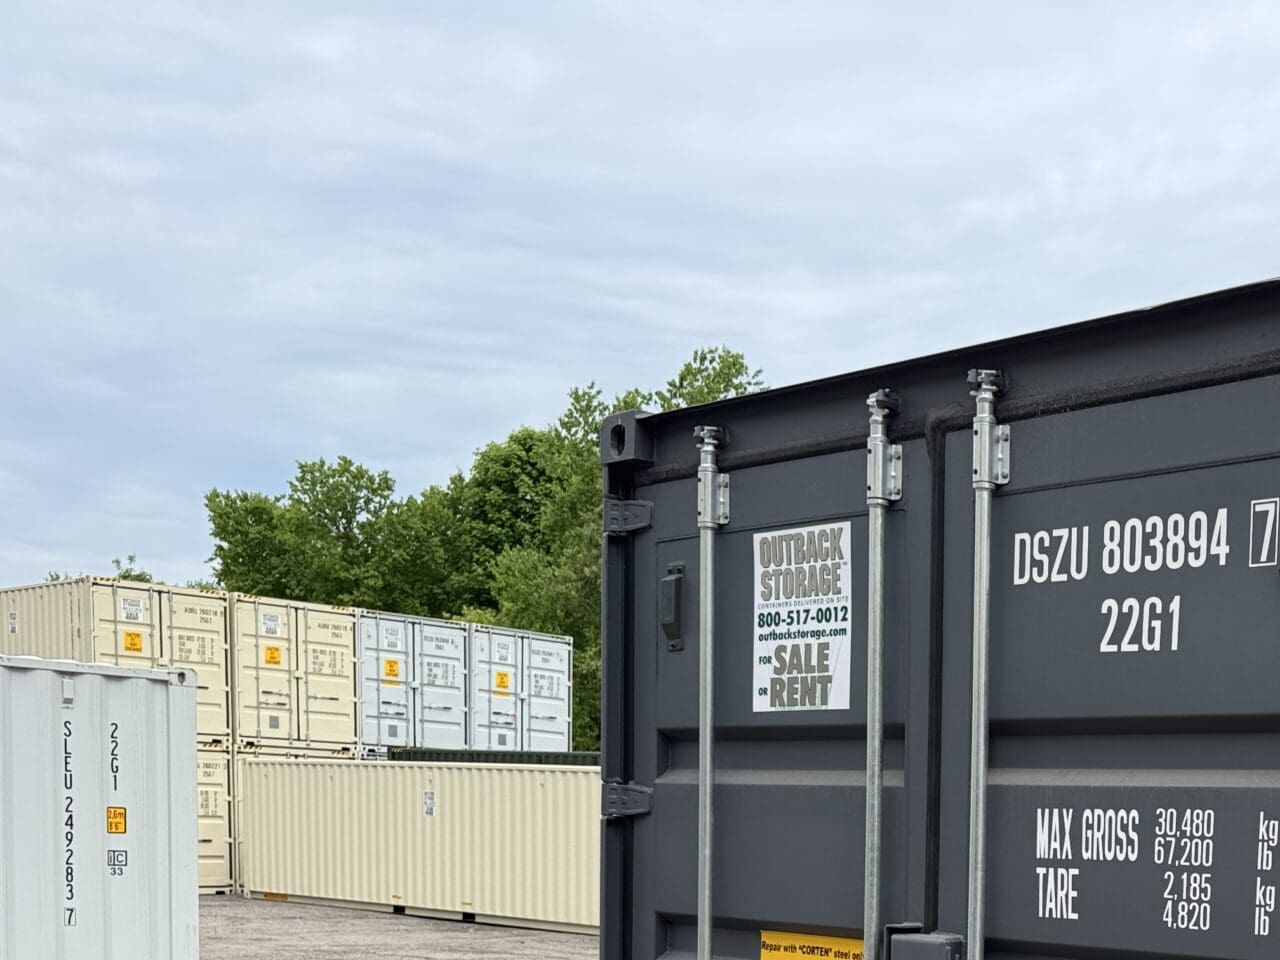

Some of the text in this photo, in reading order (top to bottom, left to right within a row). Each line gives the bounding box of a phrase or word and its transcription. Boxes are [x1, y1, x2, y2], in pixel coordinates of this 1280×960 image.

[759, 527, 844, 568] OUTBACK
[1013, 501, 1277, 585] DSZU 803894 7
[760, 562, 841, 601] STORAGE
[757, 605, 849, 628] 800-517-0012
[758, 627, 847, 641] outbackstorage.com
[1100, 595, 1181, 653] 22G1
[759, 642, 830, 676] FOR SALE
[758, 674, 833, 708] OR RENT
[110, 722, 119, 791] 22G1
[64, 720, 75, 926] SLEU 249283 7
[1036, 808, 1279, 862] MAX GROSS 30,480 kg
[110, 867, 123, 876] 33
[1153, 837, 1272, 871] 67,200 lb
[1036, 867, 1276, 920] TARE 2,185 kg
[1162, 900, 1269, 936] 4,820 lb
[761, 941, 782, 953] Repair
[783, 944, 798, 953] with
[834, 950, 850, 960] steel
